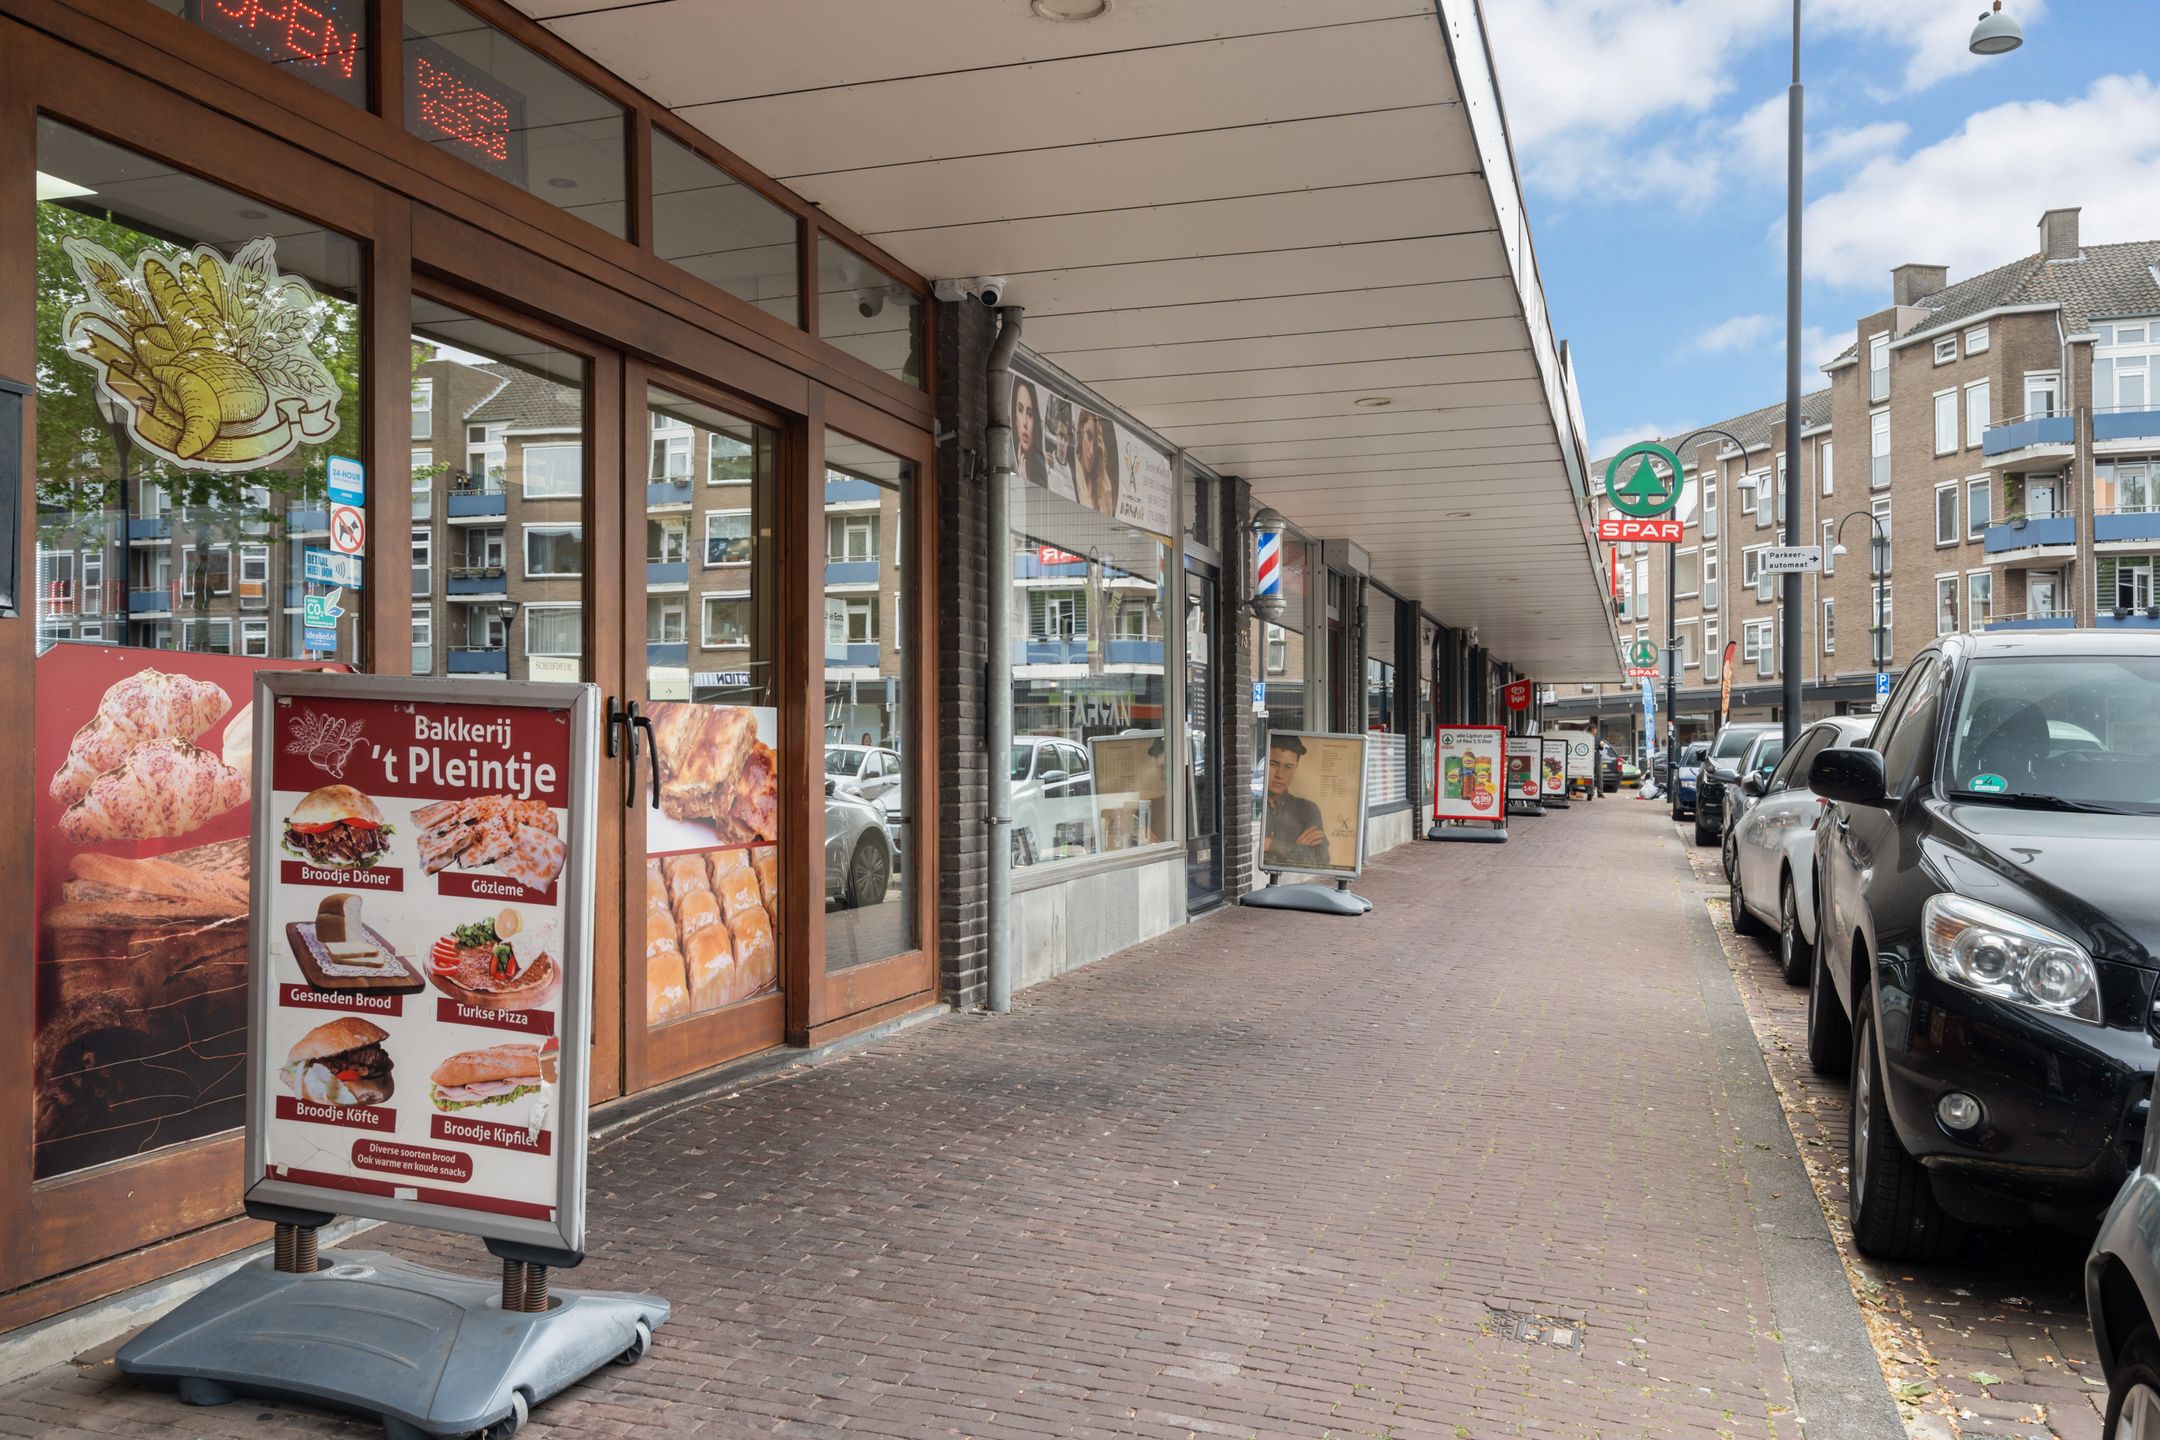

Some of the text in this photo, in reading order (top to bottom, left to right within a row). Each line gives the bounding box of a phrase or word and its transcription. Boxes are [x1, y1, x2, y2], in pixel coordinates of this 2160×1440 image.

[1602, 522, 1680, 538] SPAR
[1769, 561, 1808, 569] automaat
[414, 714, 512, 750] Bakkerij
[408, 746, 557, 801] Pleintje
[301, 865, 391, 886] Broodje Döner
[471, 880, 524, 898] Gözleme
[290, 987, 391, 1010] Gesneden Brood
[456, 1003, 529, 1025] Turkse Pizza
[296, 1102, 379, 1125] Broodje Köfte
[443, 1121, 490, 1142] Broodje
[369, 1142, 456, 1163] Diverse soorten brood
[357, 1153, 466, 1177] Ook warme en koude snacks
